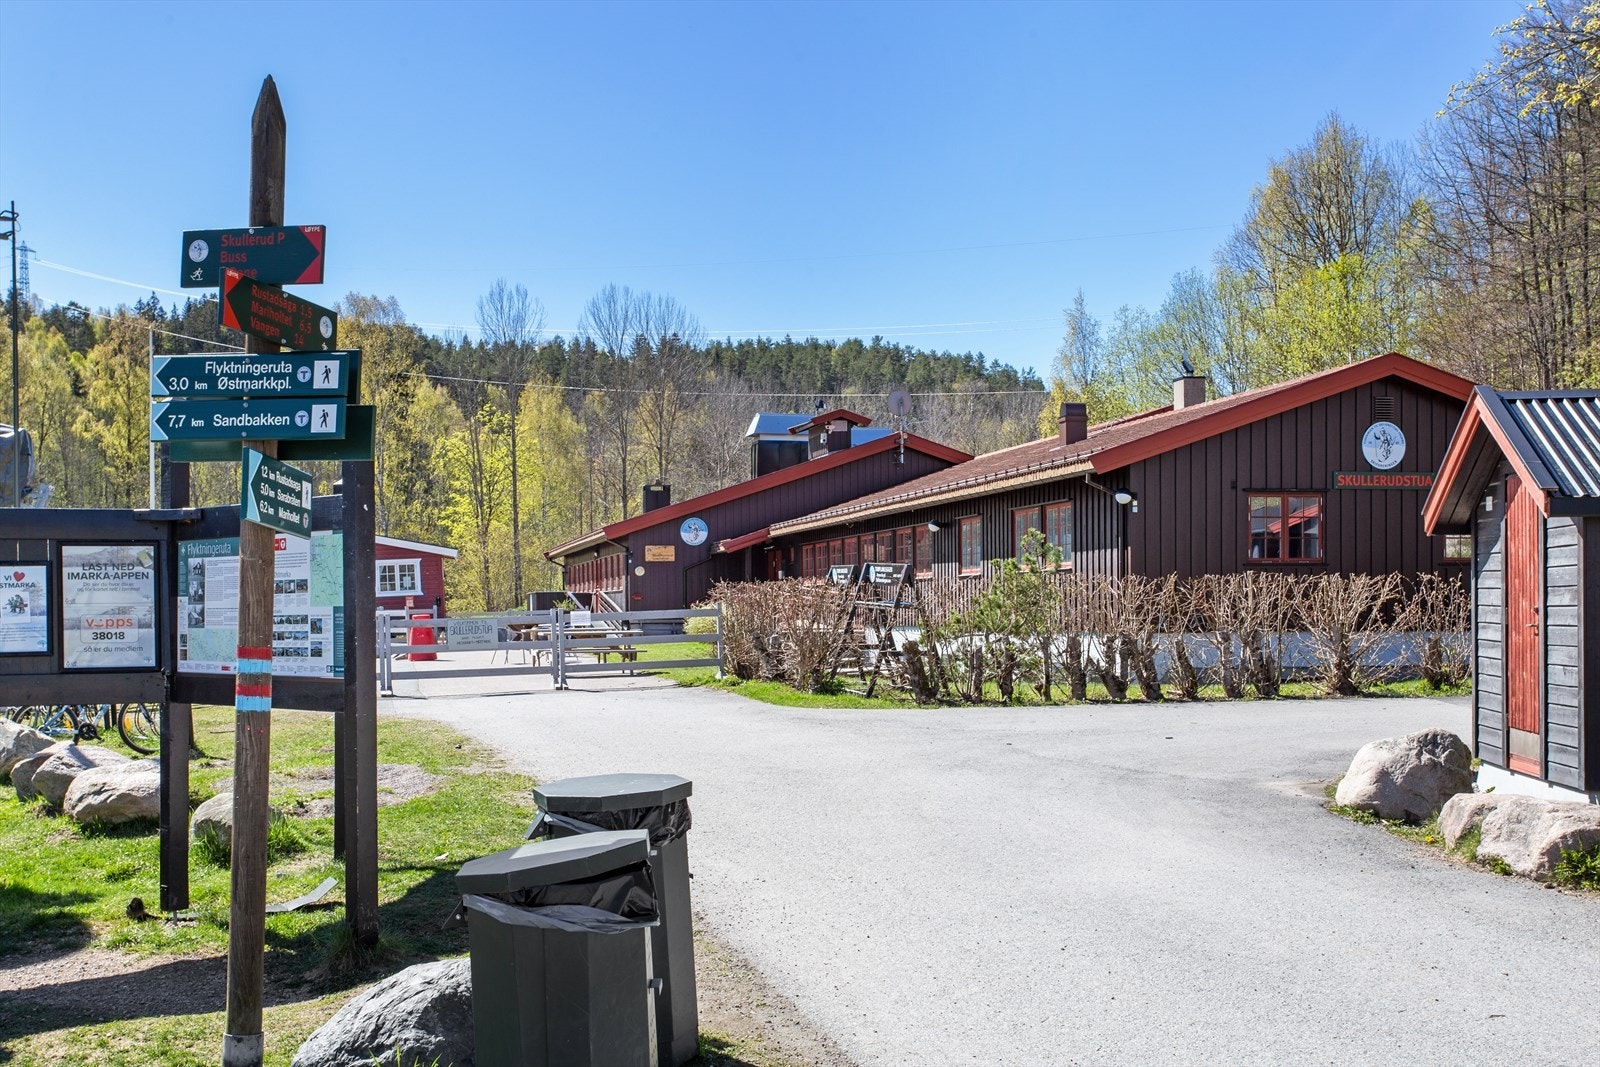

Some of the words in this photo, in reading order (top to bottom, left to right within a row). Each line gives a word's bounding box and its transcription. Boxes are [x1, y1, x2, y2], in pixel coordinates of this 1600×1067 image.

[221, 232, 274, 247] Skullerud
[278, 232, 285, 244] P
[220, 251, 247, 262] Buss
[251, 284, 297, 312] Rustadsaga
[251, 301, 292, 327] Mariholtet
[250, 316, 280, 337] Vangen
[205, 361, 292, 376] Flyktningeruta
[168, 378, 188, 392] 3,0
[194, 382, 208, 390] km
[218, 376, 292, 392] Østmarkkpl.
[168, 414, 186, 428] 7,7
[192, 418, 204, 427] km
[213, 414, 290, 426] Sandbakken
[269, 470, 275, 480] km
[276, 471, 301, 492] Rustadsaga
[1337, 474, 1432, 486] SKULLERUDSTUA
[268, 505, 274, 515] km
[278, 506, 300, 524] Mariholtet
[187, 542, 231, 558] Flyktningeruta
[82, 563, 110, 571] LAST
[112, 563, 134, 571] NED
[67, 572, 149, 580] IMARKA-APPEN
[92, 632, 125, 640] 38018
